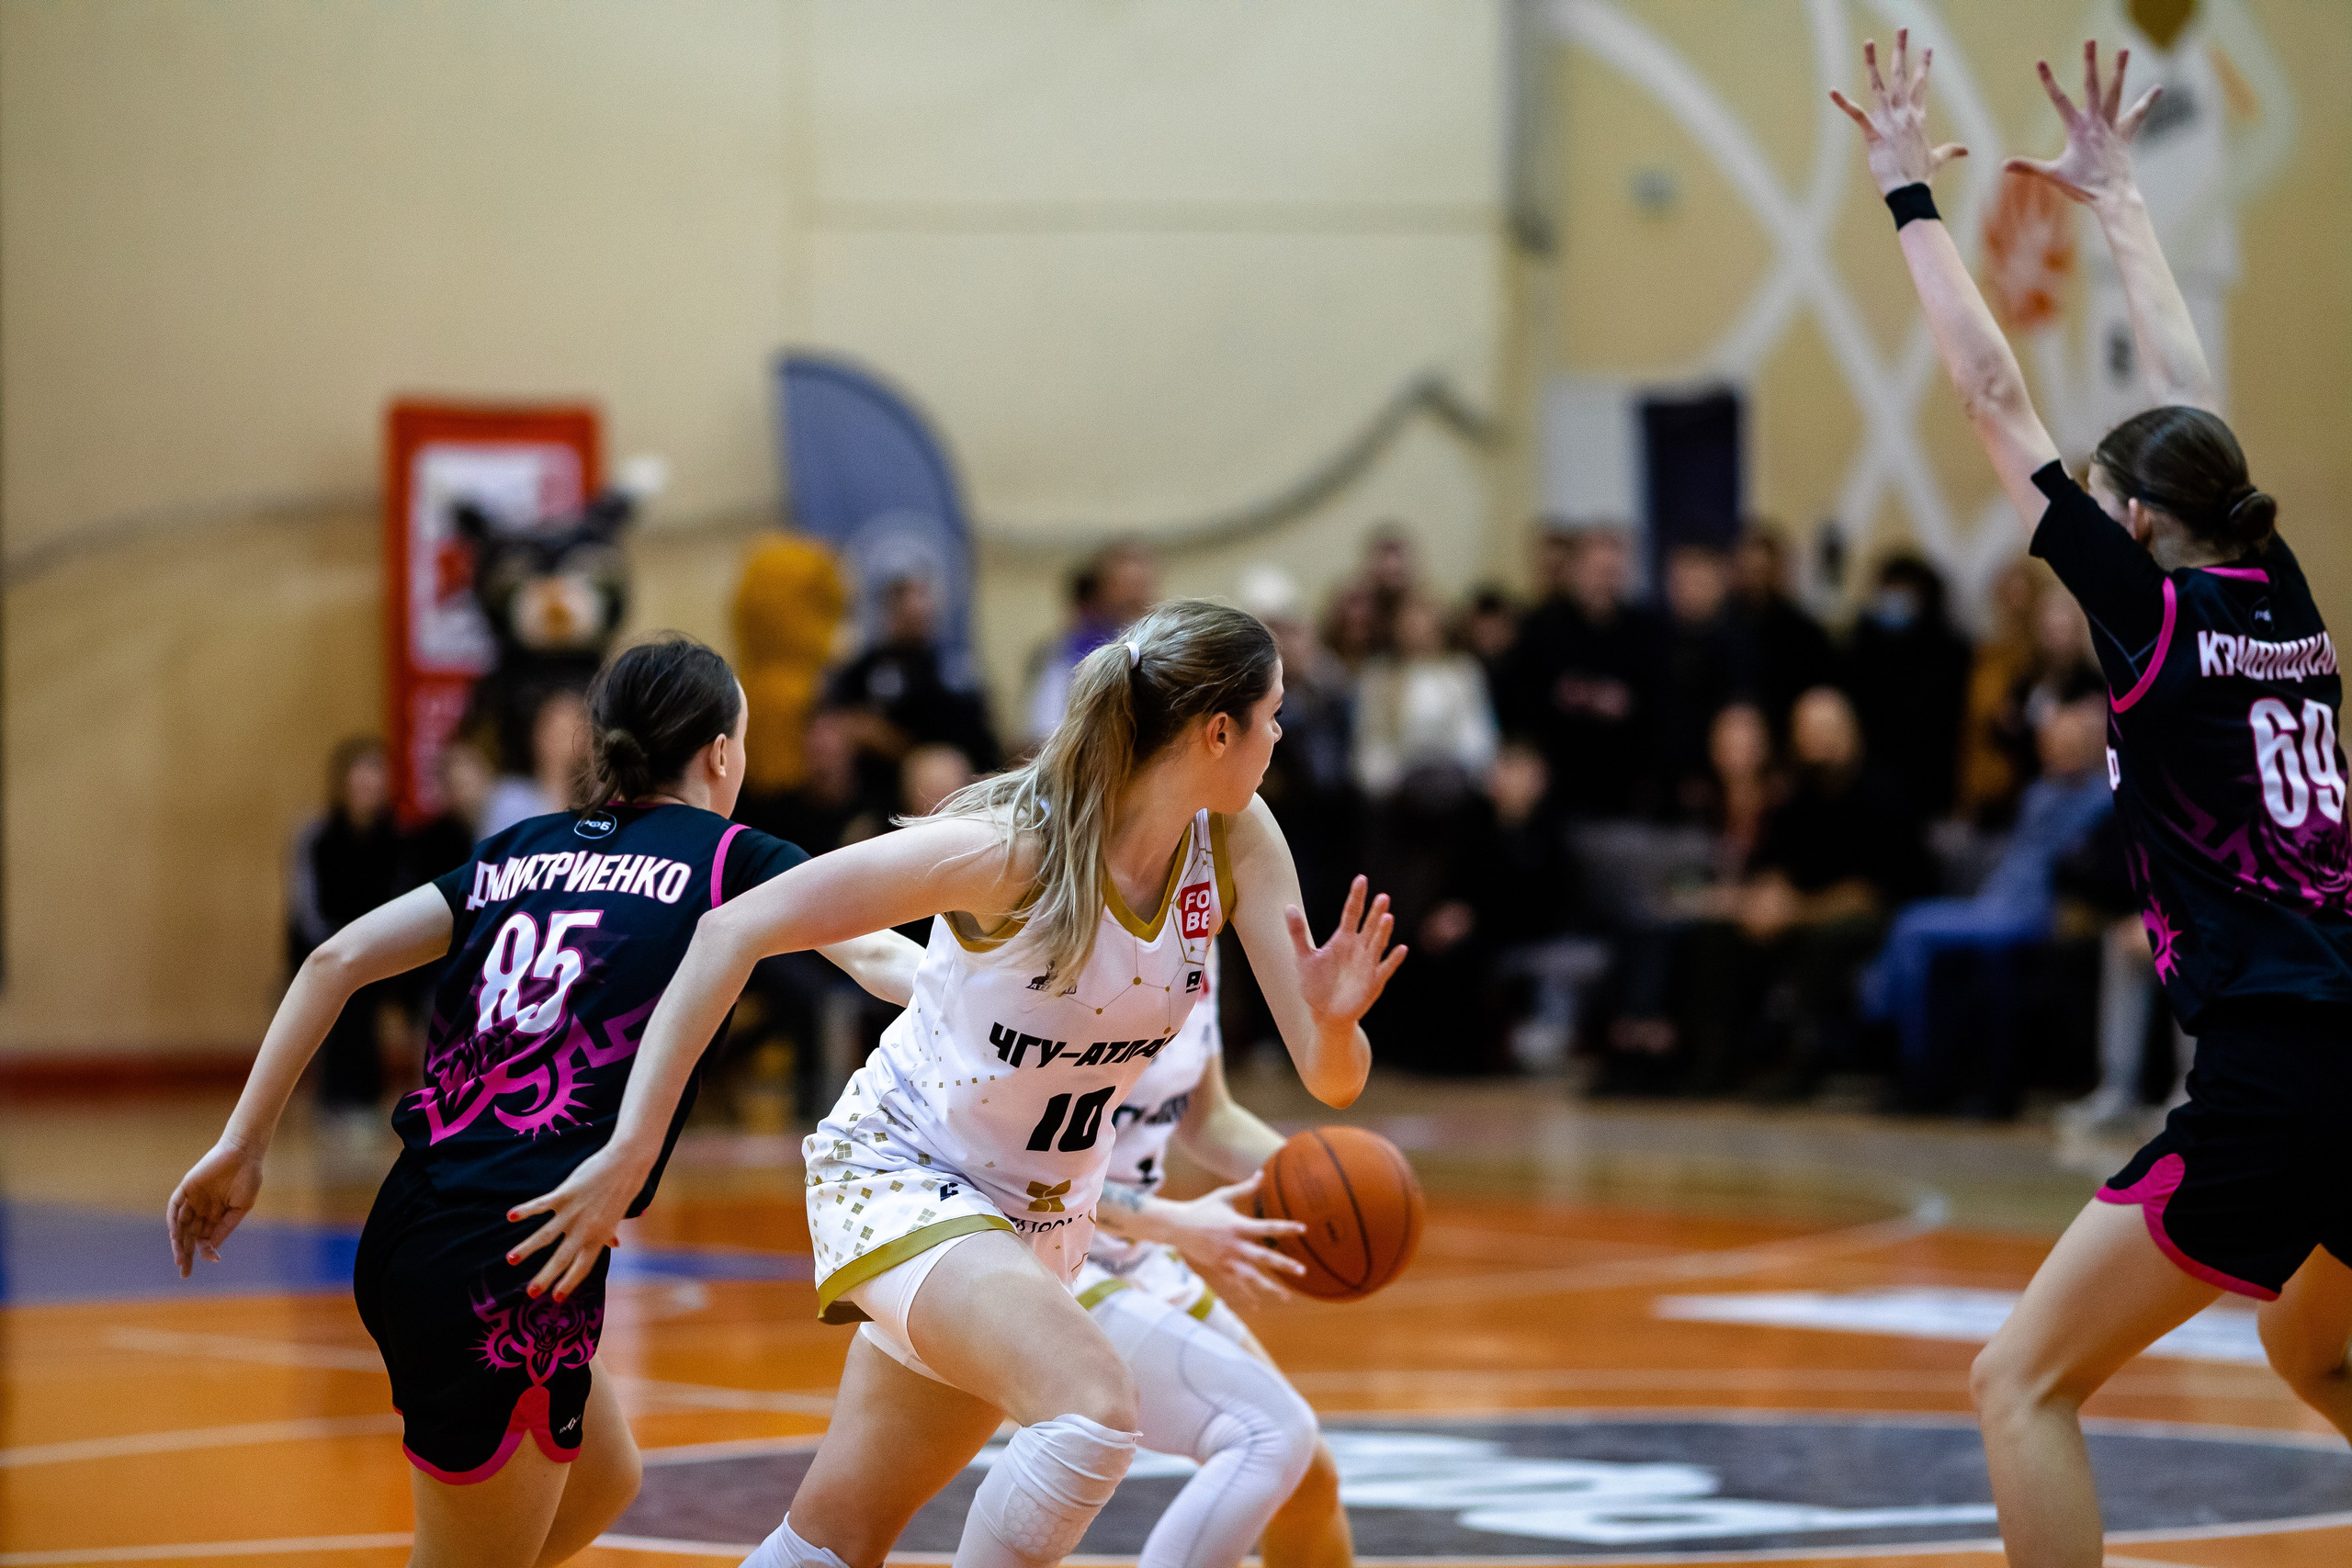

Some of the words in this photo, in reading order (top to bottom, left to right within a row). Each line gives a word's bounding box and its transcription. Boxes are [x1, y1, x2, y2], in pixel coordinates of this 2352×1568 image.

[2249, 697, 2346, 828] 69
[466, 851, 692, 911] ДМИТРИЕНКО
[1184, 889, 1210, 911] FO
[1185, 910, 1210, 931] BE
[476, 910, 604, 1035] 85
[1025, 1086, 1116, 1152] 10
